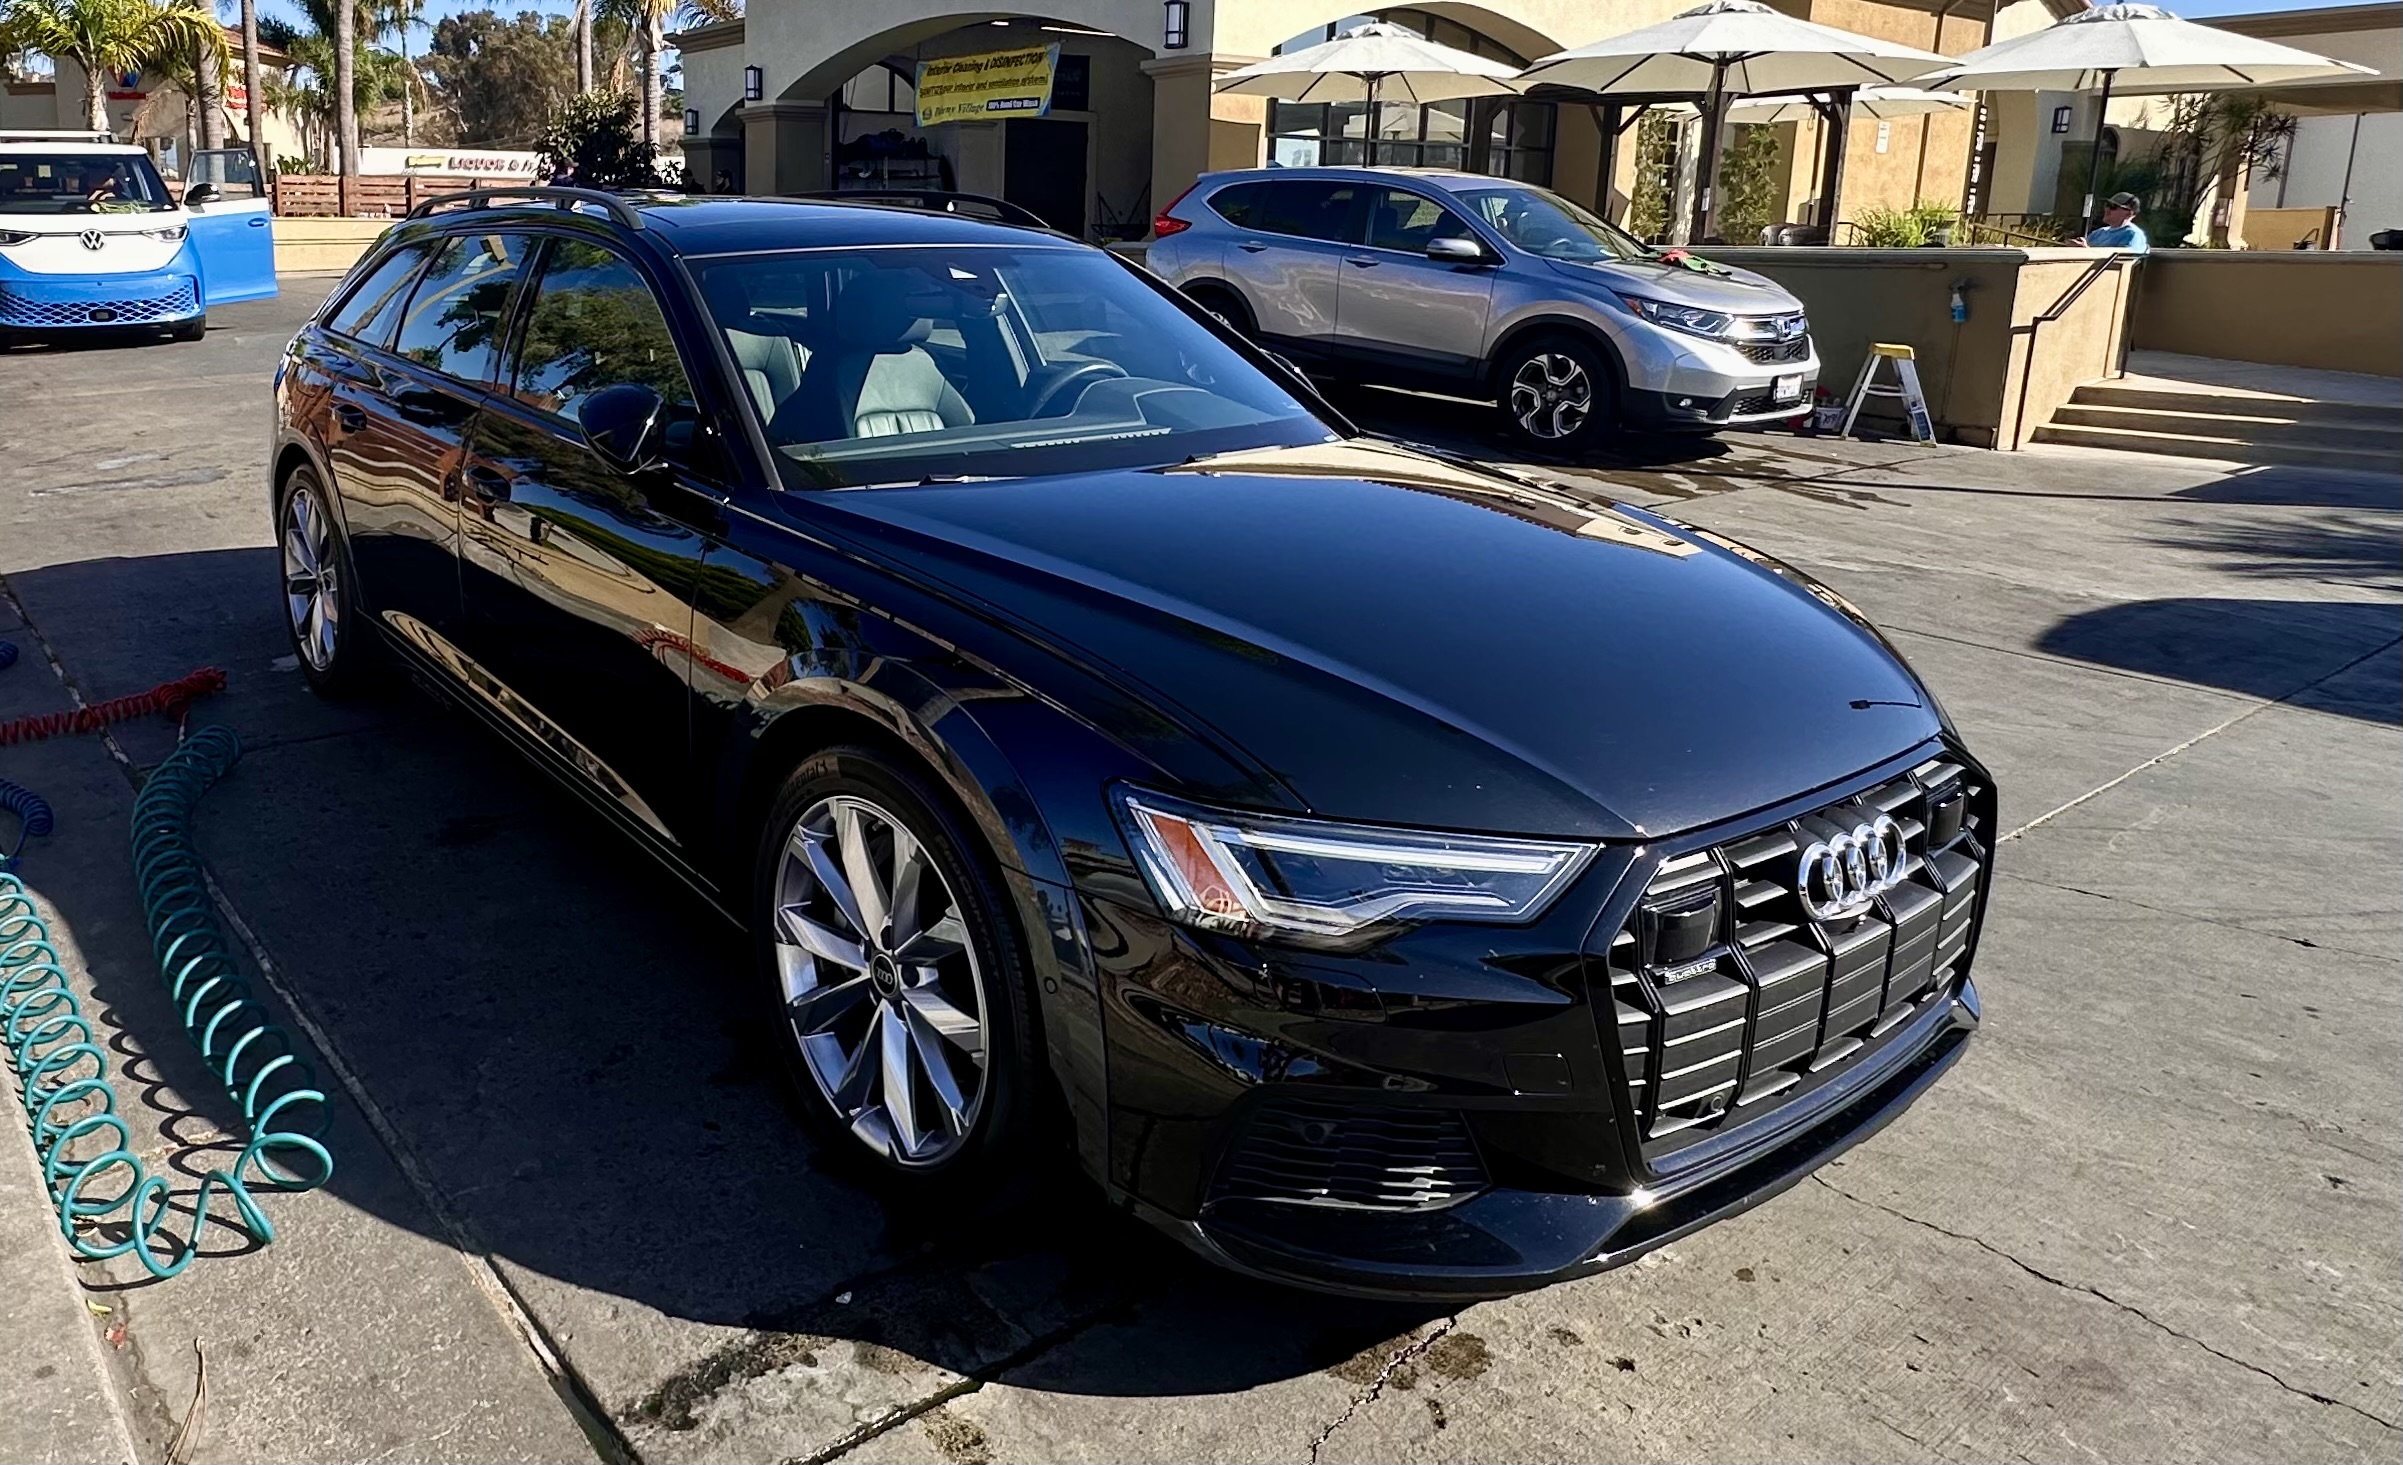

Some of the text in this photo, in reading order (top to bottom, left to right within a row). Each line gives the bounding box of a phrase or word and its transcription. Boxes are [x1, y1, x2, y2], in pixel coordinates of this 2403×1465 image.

[952, 60, 983, 74] Cleaning
[990, 52, 1045, 68] DISINFECTION
[448, 157, 505, 171] LIQUOR
[508, 159, 519, 172] &
